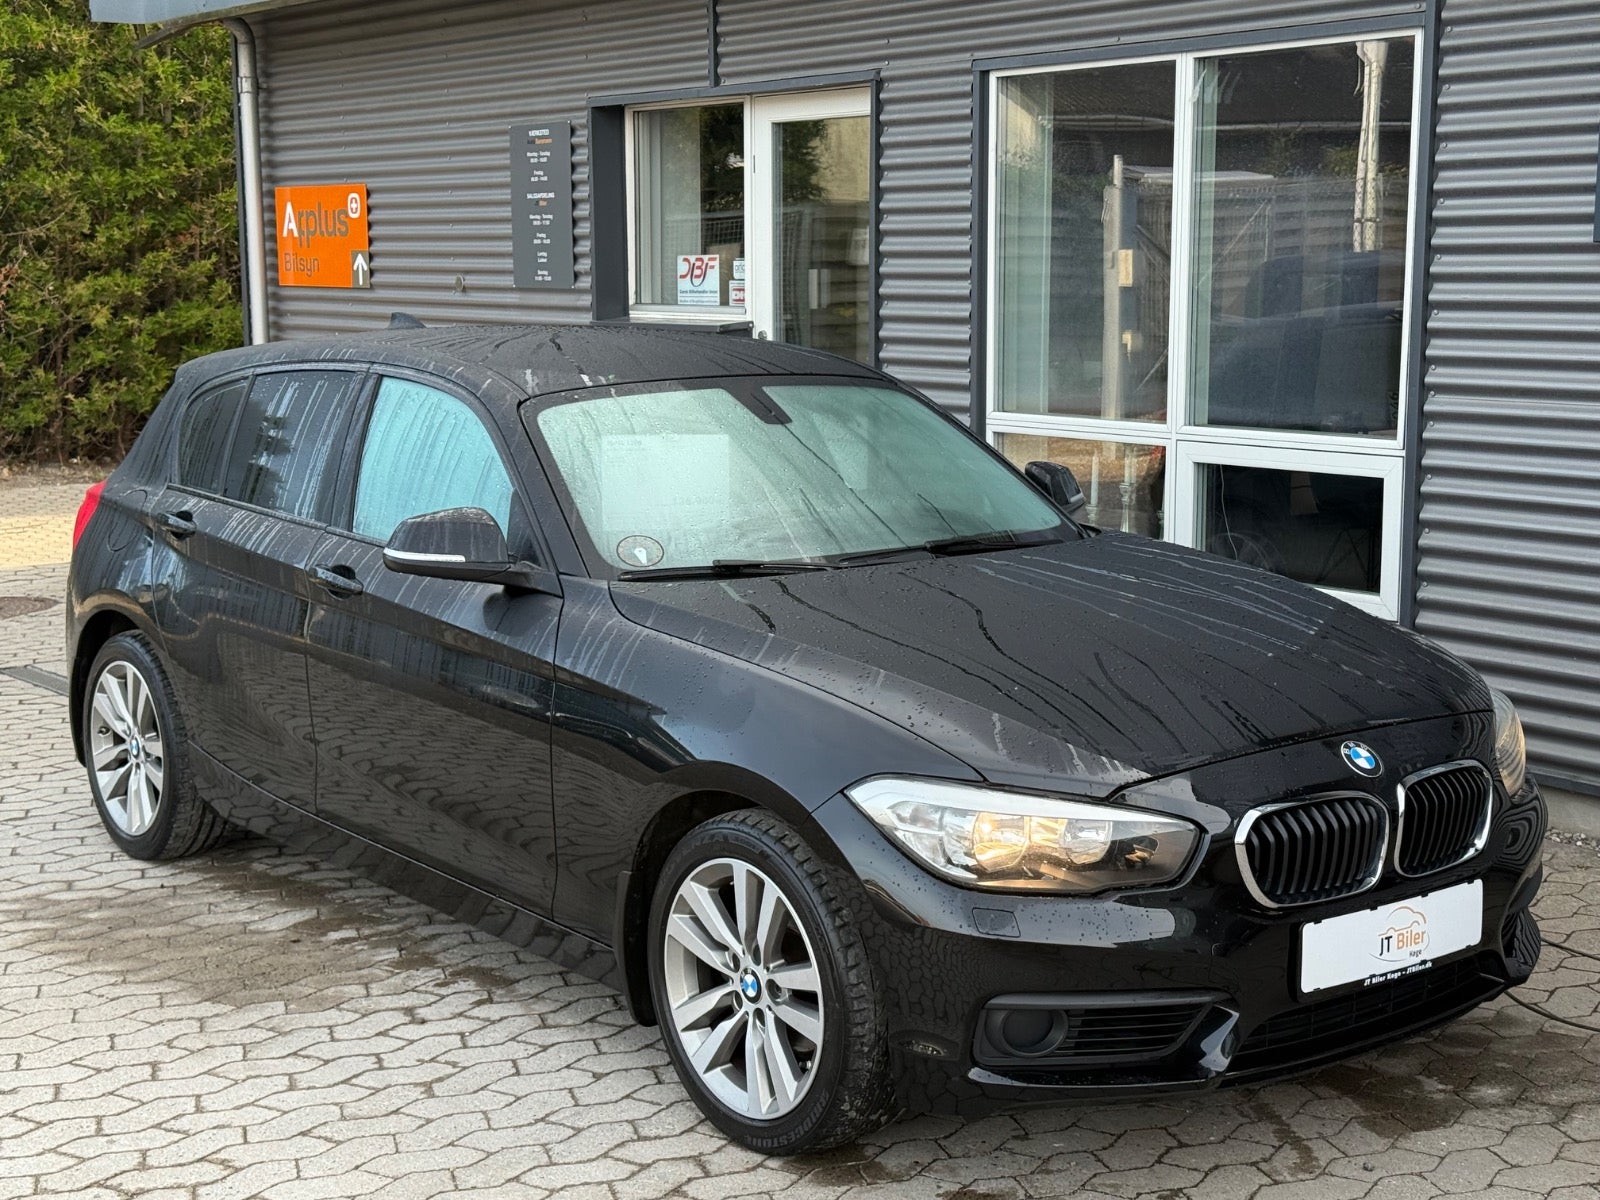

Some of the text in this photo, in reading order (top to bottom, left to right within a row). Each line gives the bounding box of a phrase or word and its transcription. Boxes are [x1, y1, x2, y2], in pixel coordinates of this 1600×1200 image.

[284, 253, 320, 277] Bilsyn
[1379, 929, 1426, 957] JT Biler
